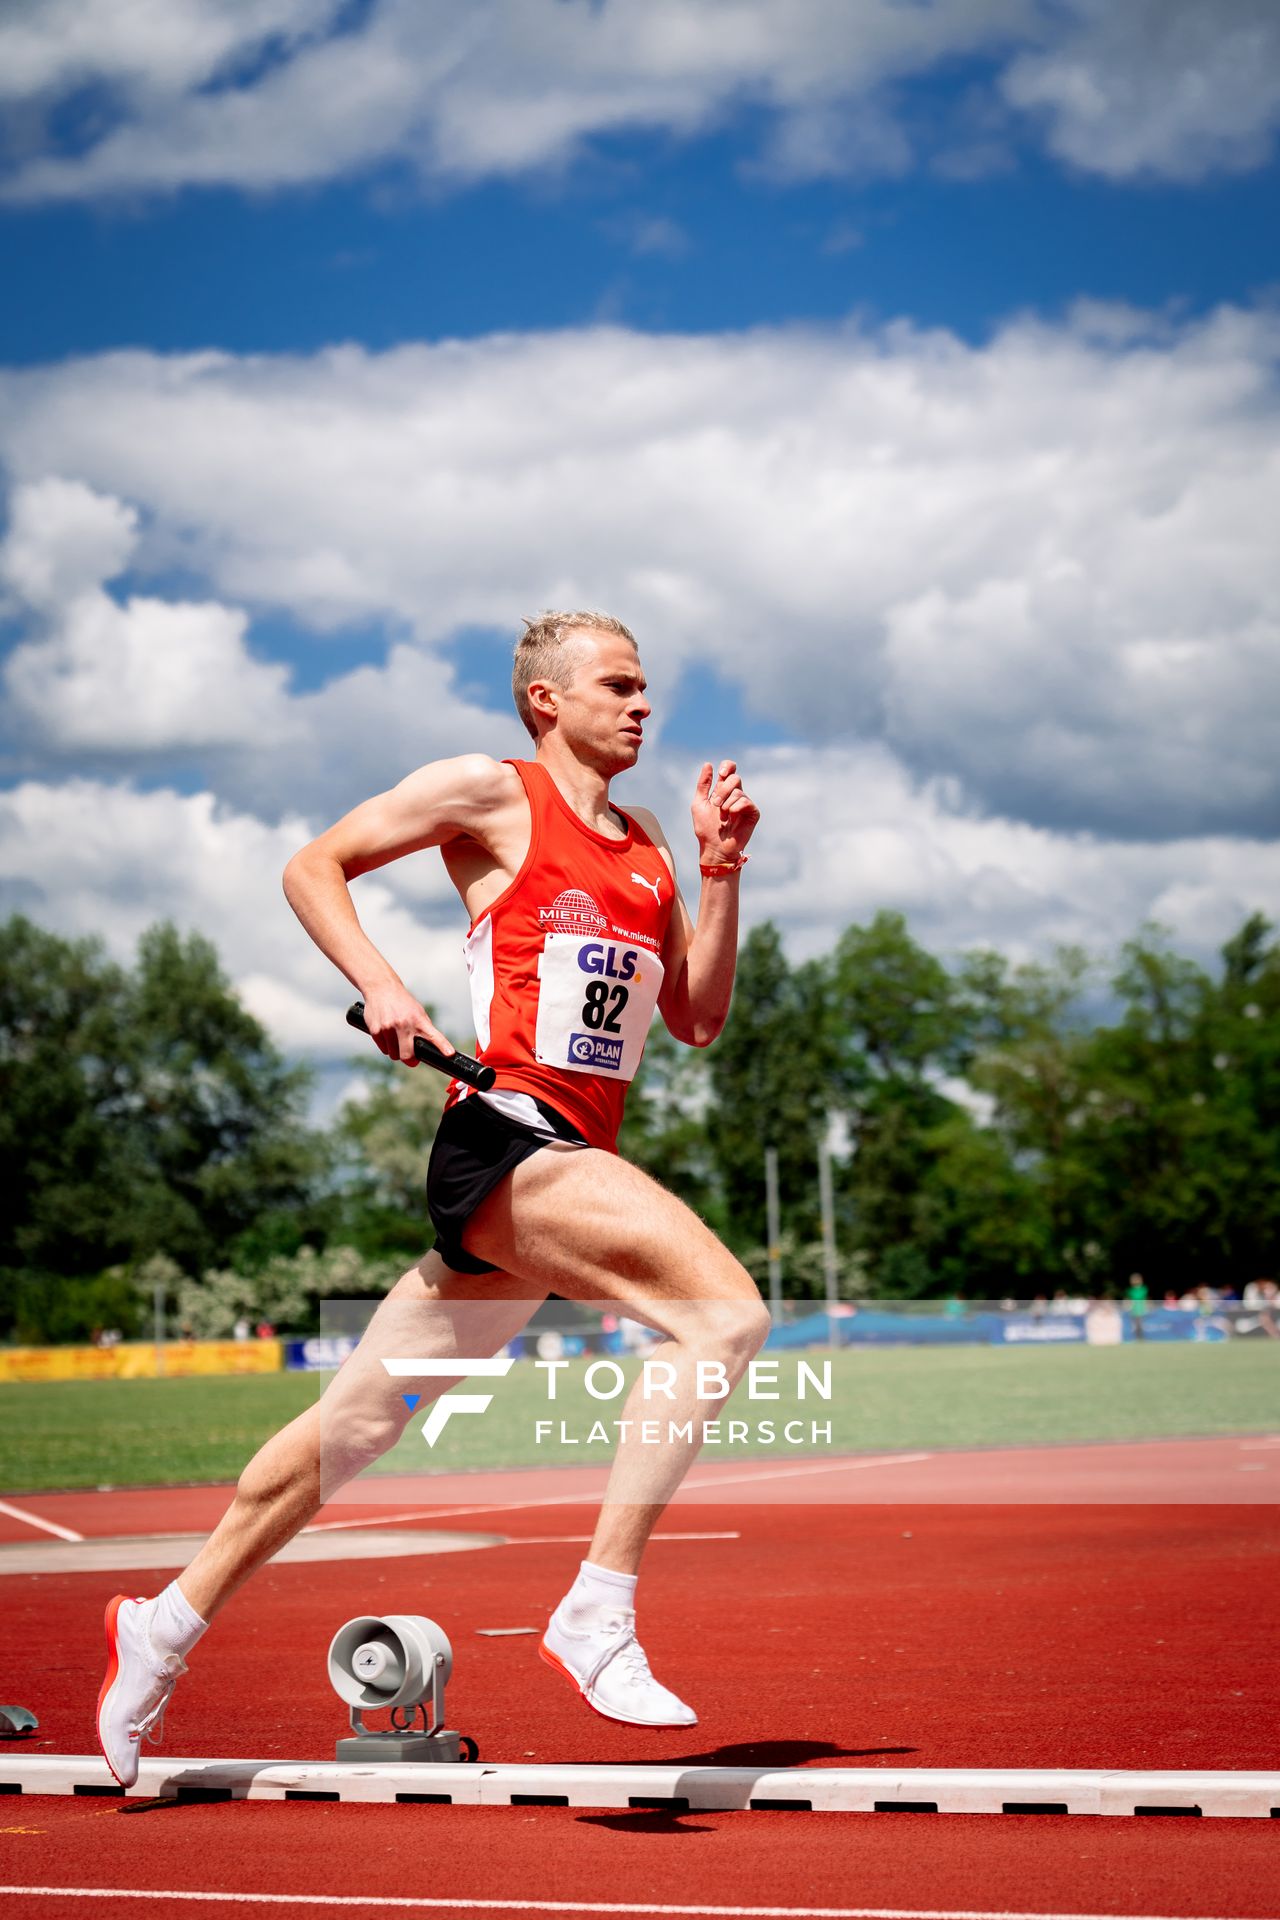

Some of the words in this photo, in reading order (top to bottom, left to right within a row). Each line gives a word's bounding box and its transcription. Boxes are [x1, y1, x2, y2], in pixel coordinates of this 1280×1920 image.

[540, 909, 607, 927] MIETENS
[581, 980, 629, 1034] 82
[595, 1042, 620, 1059] PLAN
